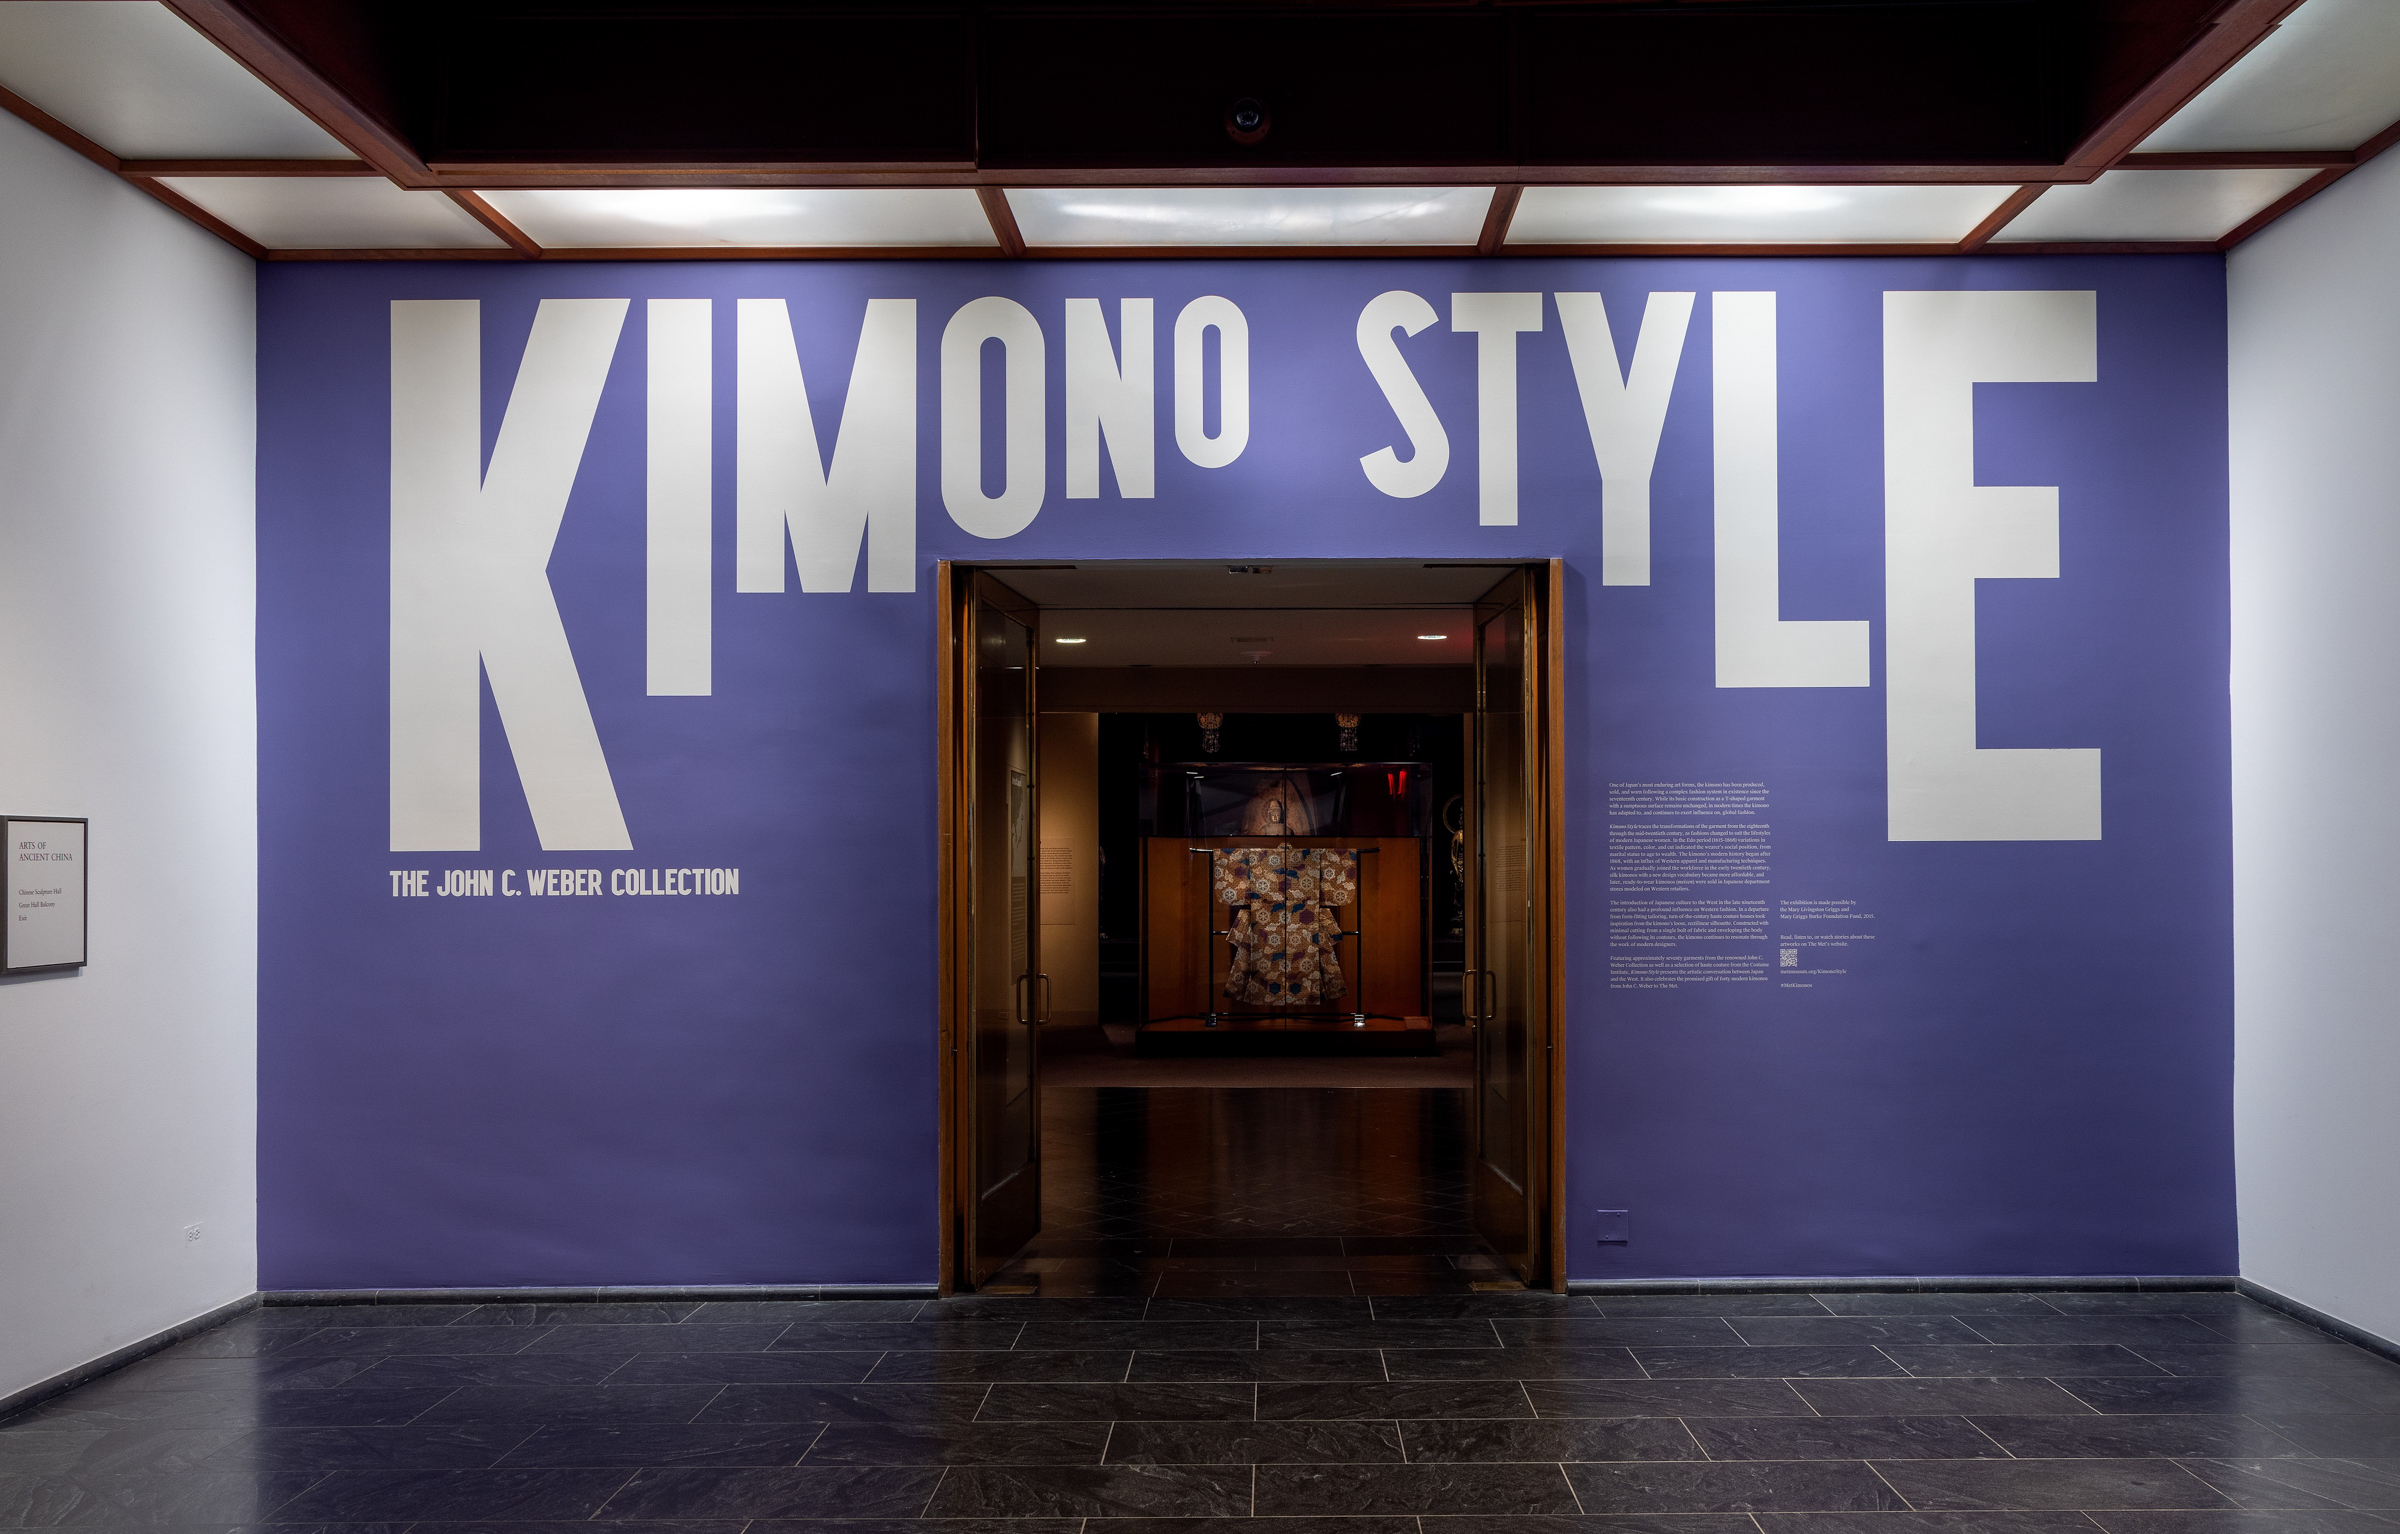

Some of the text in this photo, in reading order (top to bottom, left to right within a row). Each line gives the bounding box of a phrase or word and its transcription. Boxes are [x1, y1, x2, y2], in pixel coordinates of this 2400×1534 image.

[390, 291, 2101, 851] KIMONO STYLE
[19, 842, 35, 850] ARTS
[19, 853, 73, 861] ANCIENT CHINA
[390, 868, 739, 897] THE JOHN C. WEBER COLLECTION
[40, 901, 55, 909] Balcony
